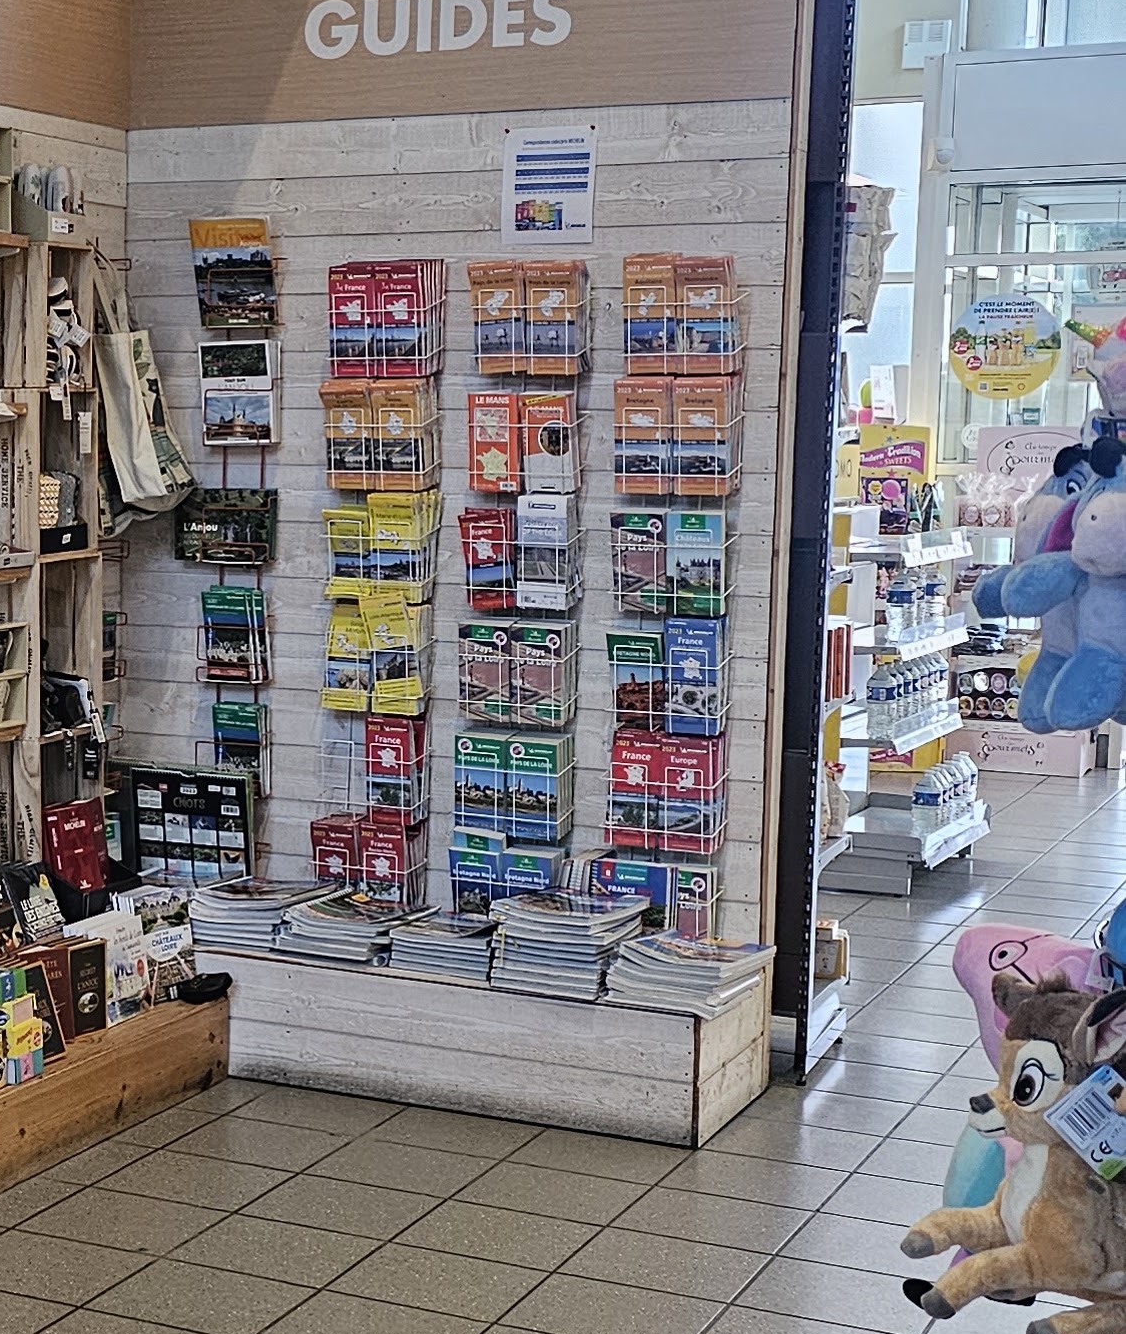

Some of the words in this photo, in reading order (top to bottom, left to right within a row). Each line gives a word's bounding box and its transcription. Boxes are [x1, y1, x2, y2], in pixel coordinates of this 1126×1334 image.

[344, 283, 366, 291] France
[390, 282, 411, 291] France
[475, 396, 484, 404] LE
[485, 396, 509, 404] MANS
[886, 446, 922, 459] Tradition
[884, 456, 912, 467] SWEETS
[183, 522, 218, 533] L'Anjou
[627, 533, 648, 544] Pays
[677, 637, 703, 646] France
[474, 644, 493, 654] Pays
[526, 648, 545, 657] Pays
[374, 735, 401, 745] France
[622, 750, 651, 761] France
[670, 756, 698, 765] Europe
[370, 840, 393, 849] France
